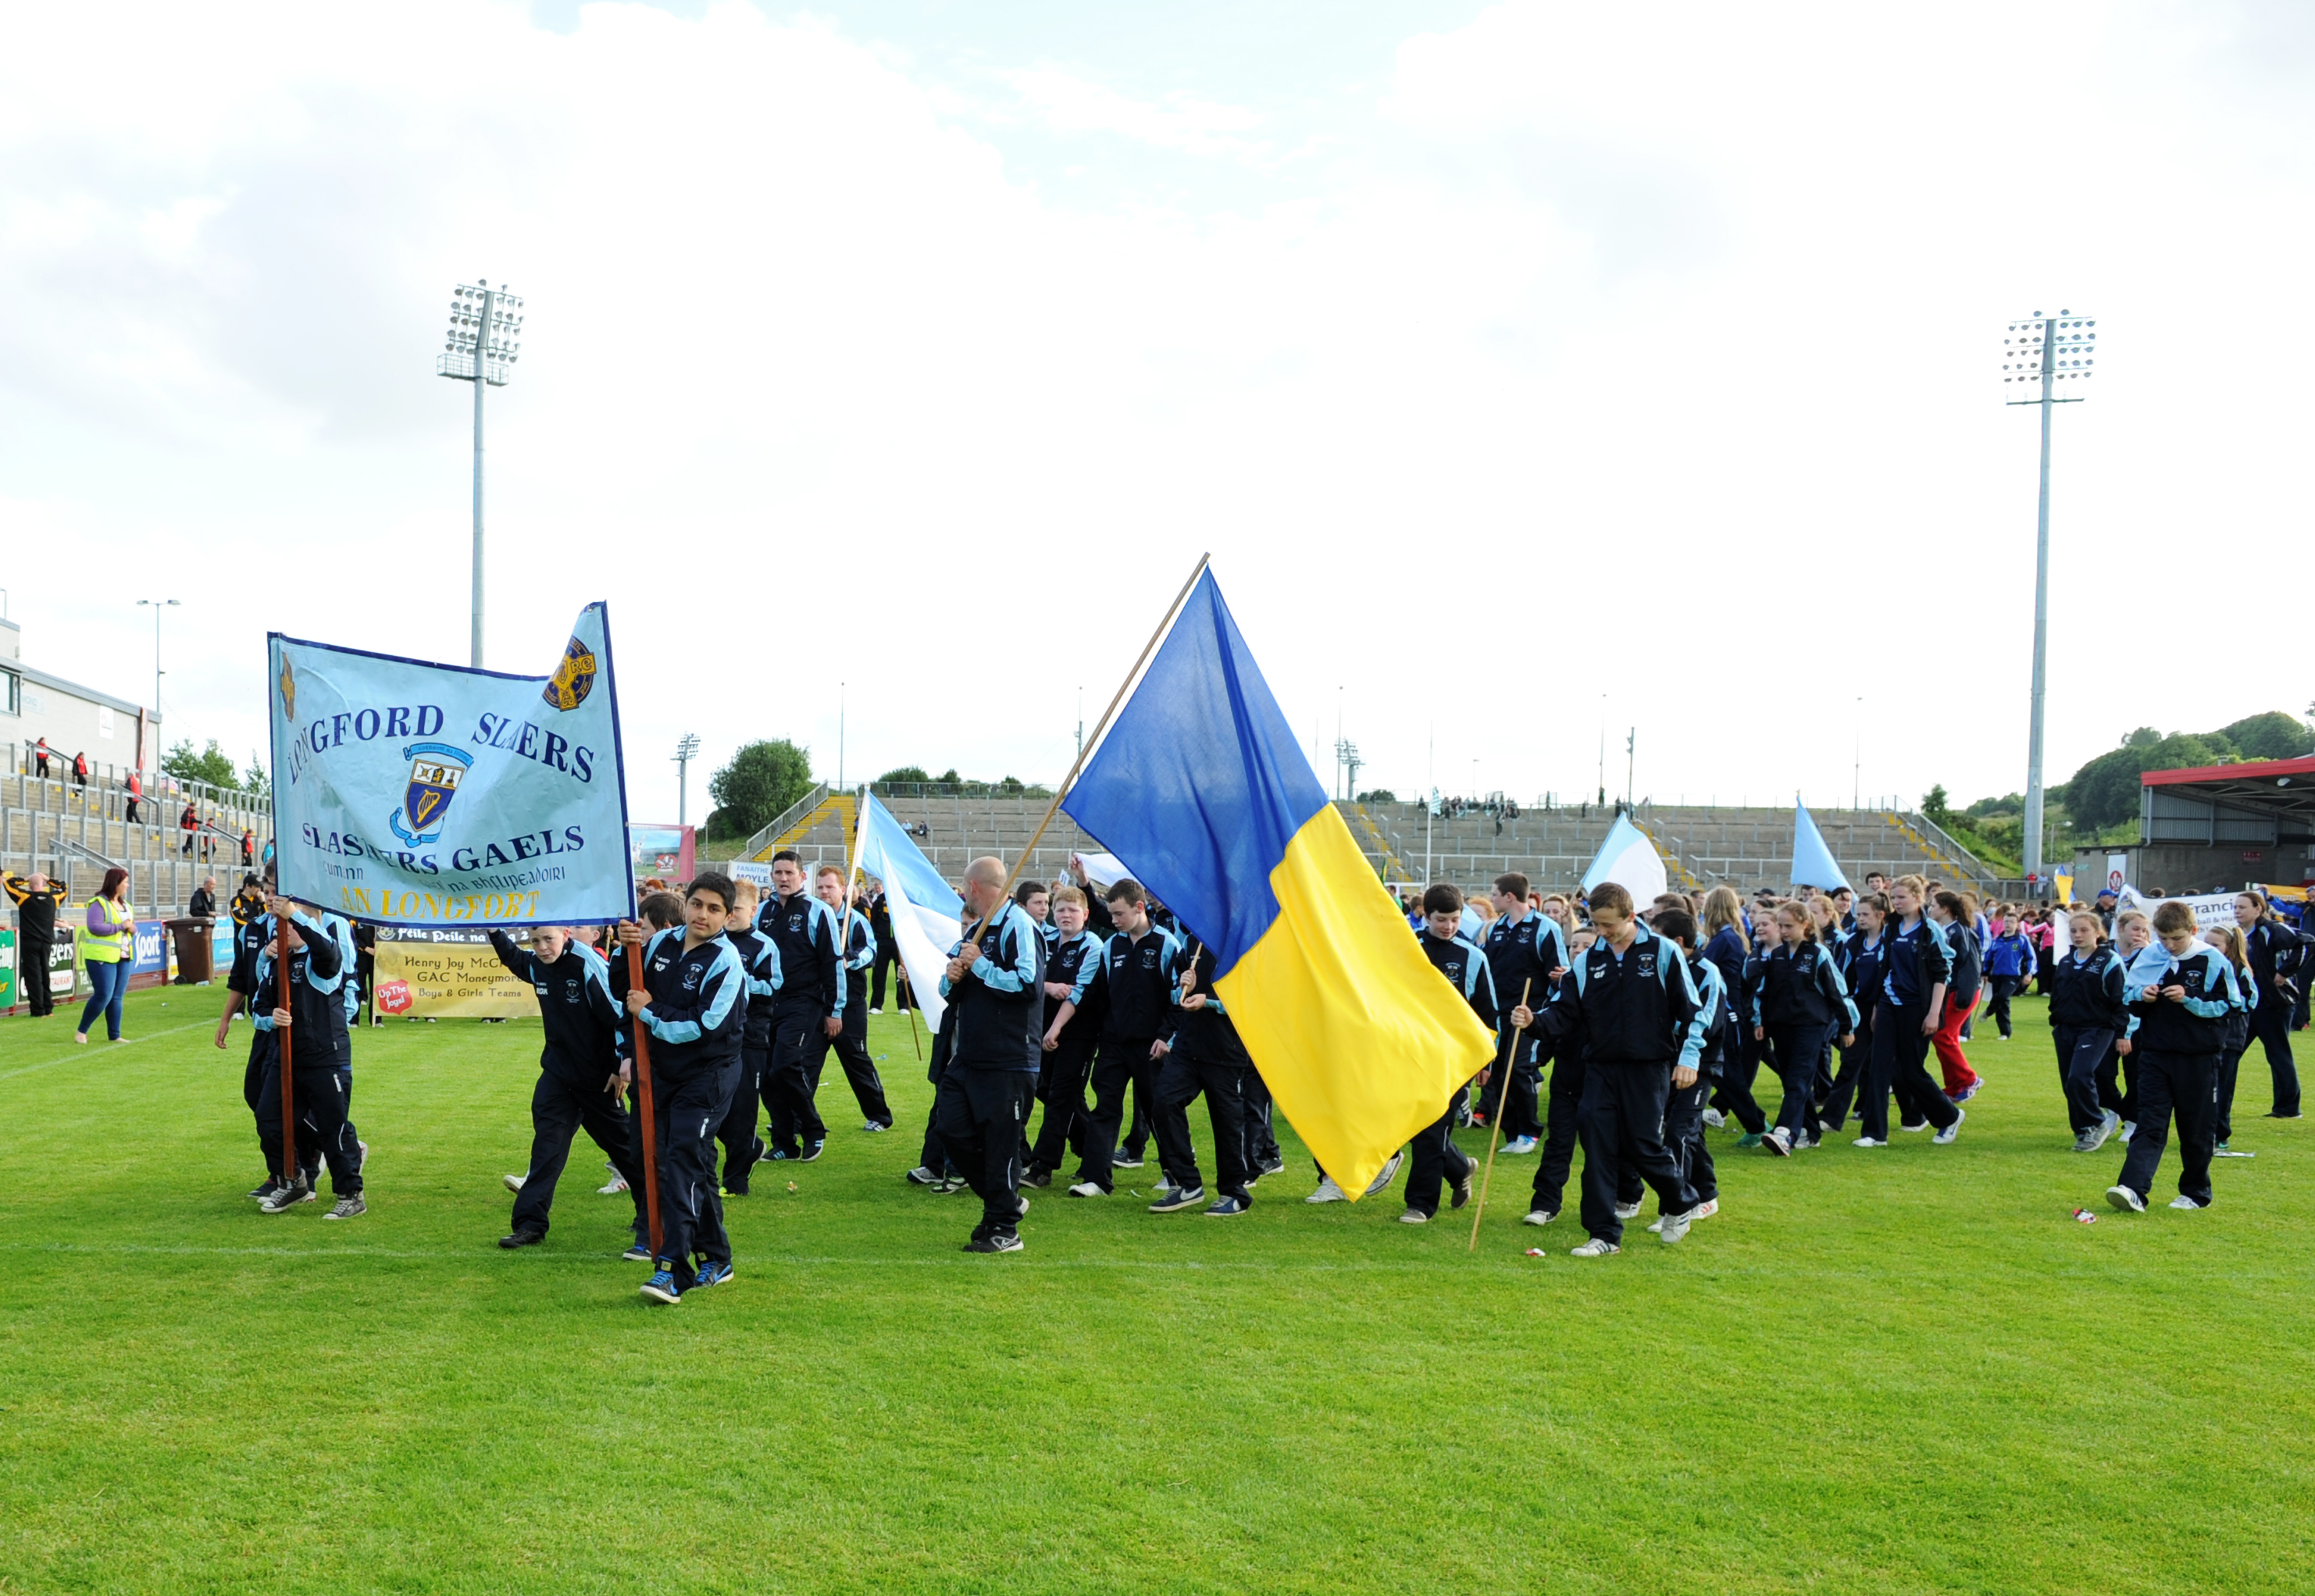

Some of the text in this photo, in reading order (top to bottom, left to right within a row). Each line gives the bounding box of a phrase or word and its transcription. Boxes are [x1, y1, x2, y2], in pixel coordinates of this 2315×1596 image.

[287, 704, 444, 786] LONGFORD
[302, 822, 584, 875] SLASHERS GAELS
[737, 873, 769, 884] MOYLE
[341, 885, 541, 921] AN LONGFORT
[2188, 898, 2233, 915] Franci
[469, 934, 486, 942] na
[134, 931, 161, 969] Sport
[405, 956, 441, 970] Henry
[446, 957, 465, 970] Joy
[417, 972, 450, 983] GAC
[457, 973, 523, 985] Moneymore
[378, 985, 407, 999] Up The
[419, 988, 522, 999] Boys & Girls Teams
